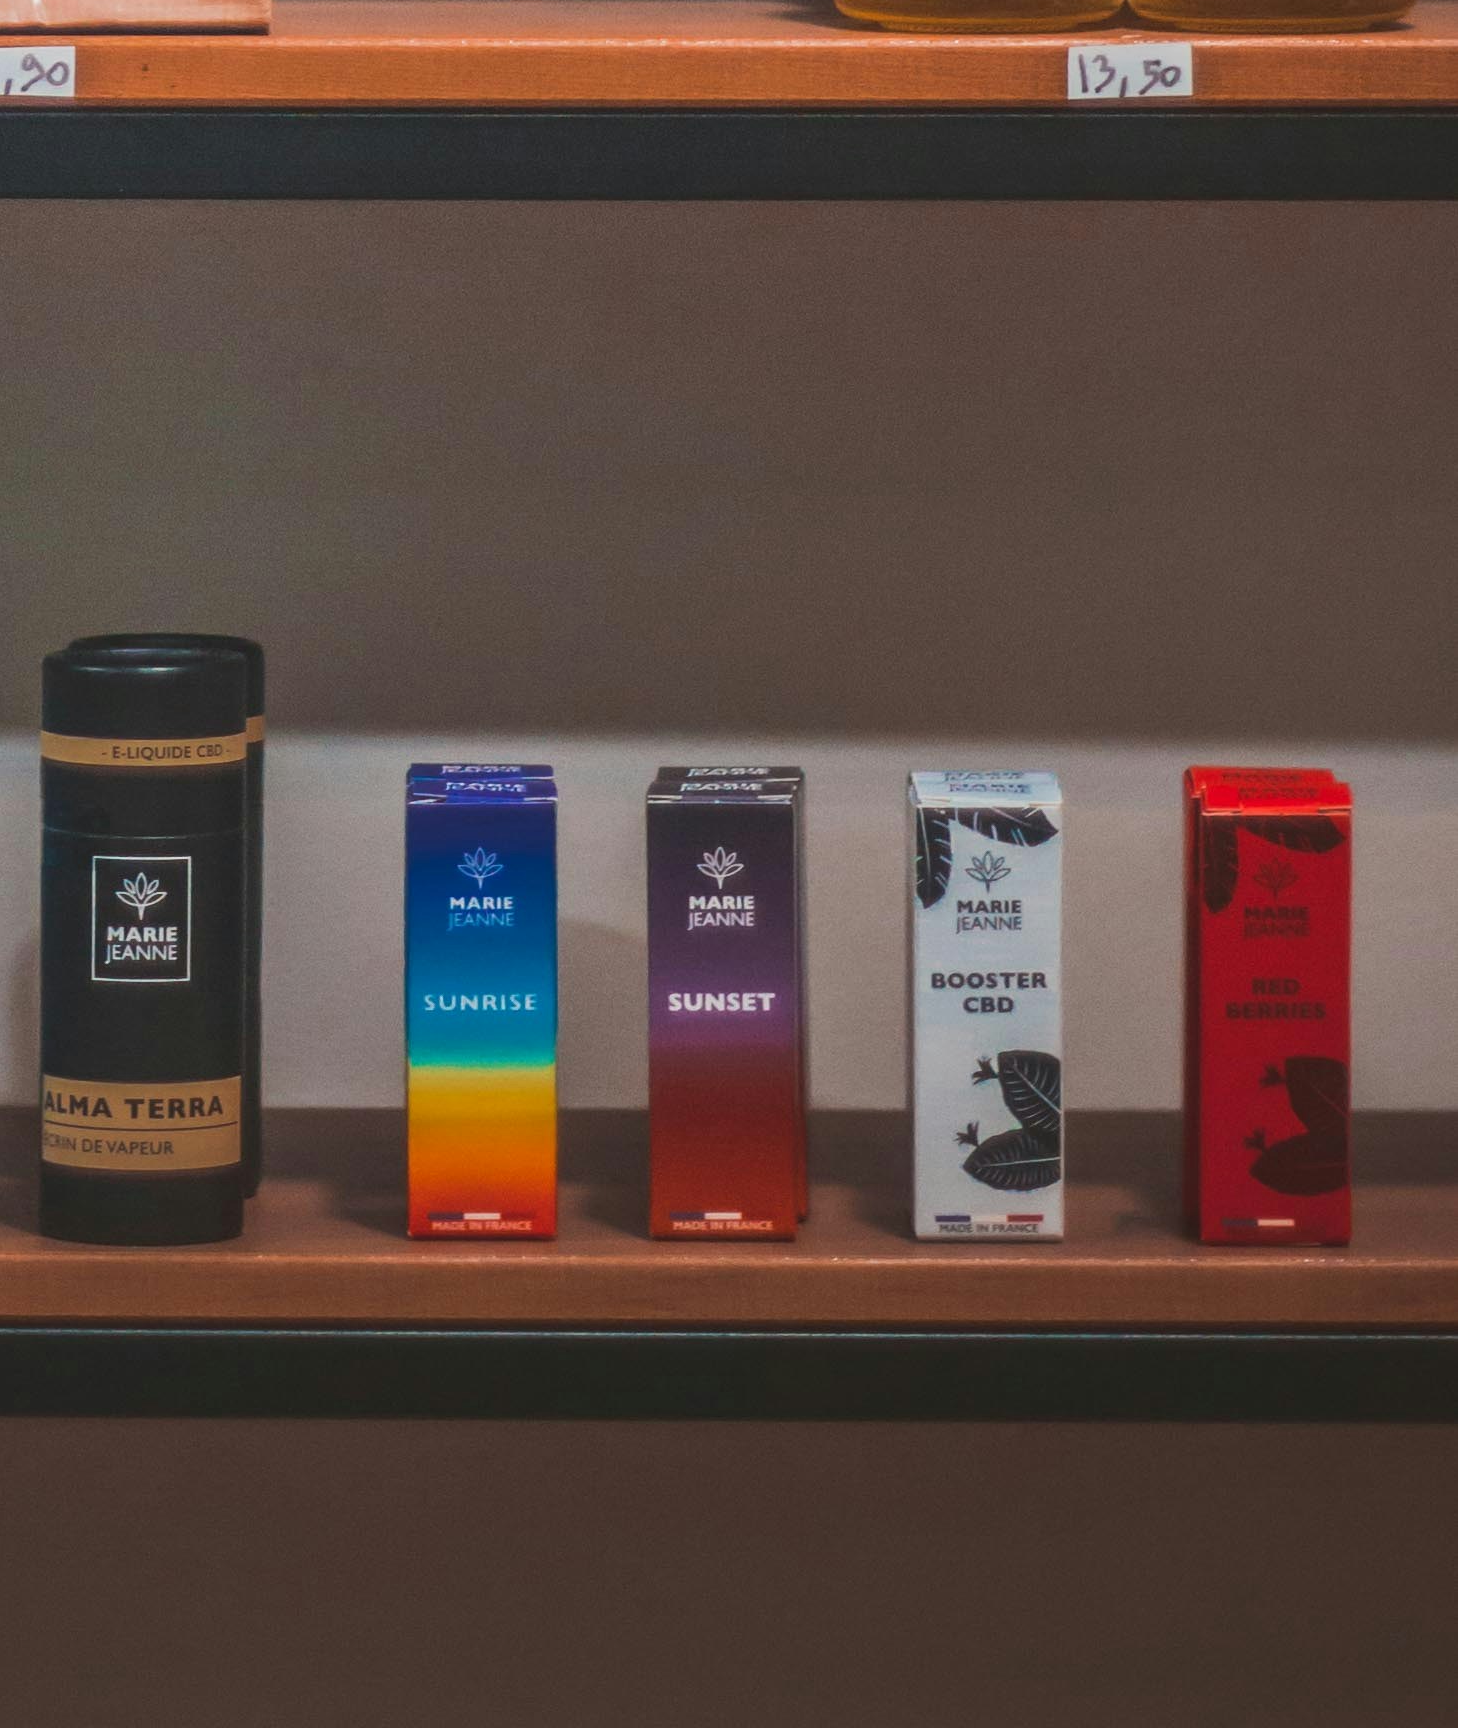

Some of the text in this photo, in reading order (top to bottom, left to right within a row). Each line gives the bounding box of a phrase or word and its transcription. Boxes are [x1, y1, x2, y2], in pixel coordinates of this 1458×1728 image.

[1079, 54, 1181, 98] 13,50
[112, 744, 222, 760] E-LIQUIDE CBD
[449, 896, 513, 909] MARIE
[689, 896, 754, 910] MARIE
[958, 900, 1021, 914] MARIE
[448, 912, 514, 930] JEANNE
[688, 912, 754, 930] JEANNE
[956, 916, 1022, 933] JEANNE
[107, 926, 177, 942] MARIE
[106, 944, 178, 963] JEANNE
[931, 973, 1047, 989] BOOSTER
[1252, 978, 1301, 995] RED
[424, 994, 537, 1011] SUNRISE
[668, 993, 775, 1011] SUNSET
[963, 997, 1013, 1013] CBD
[1226, 1002, 1326, 1019] BERRIES
[124, 1096, 223, 1119] TERRA
[82, 1139, 174, 1155] DE VAPEUR
